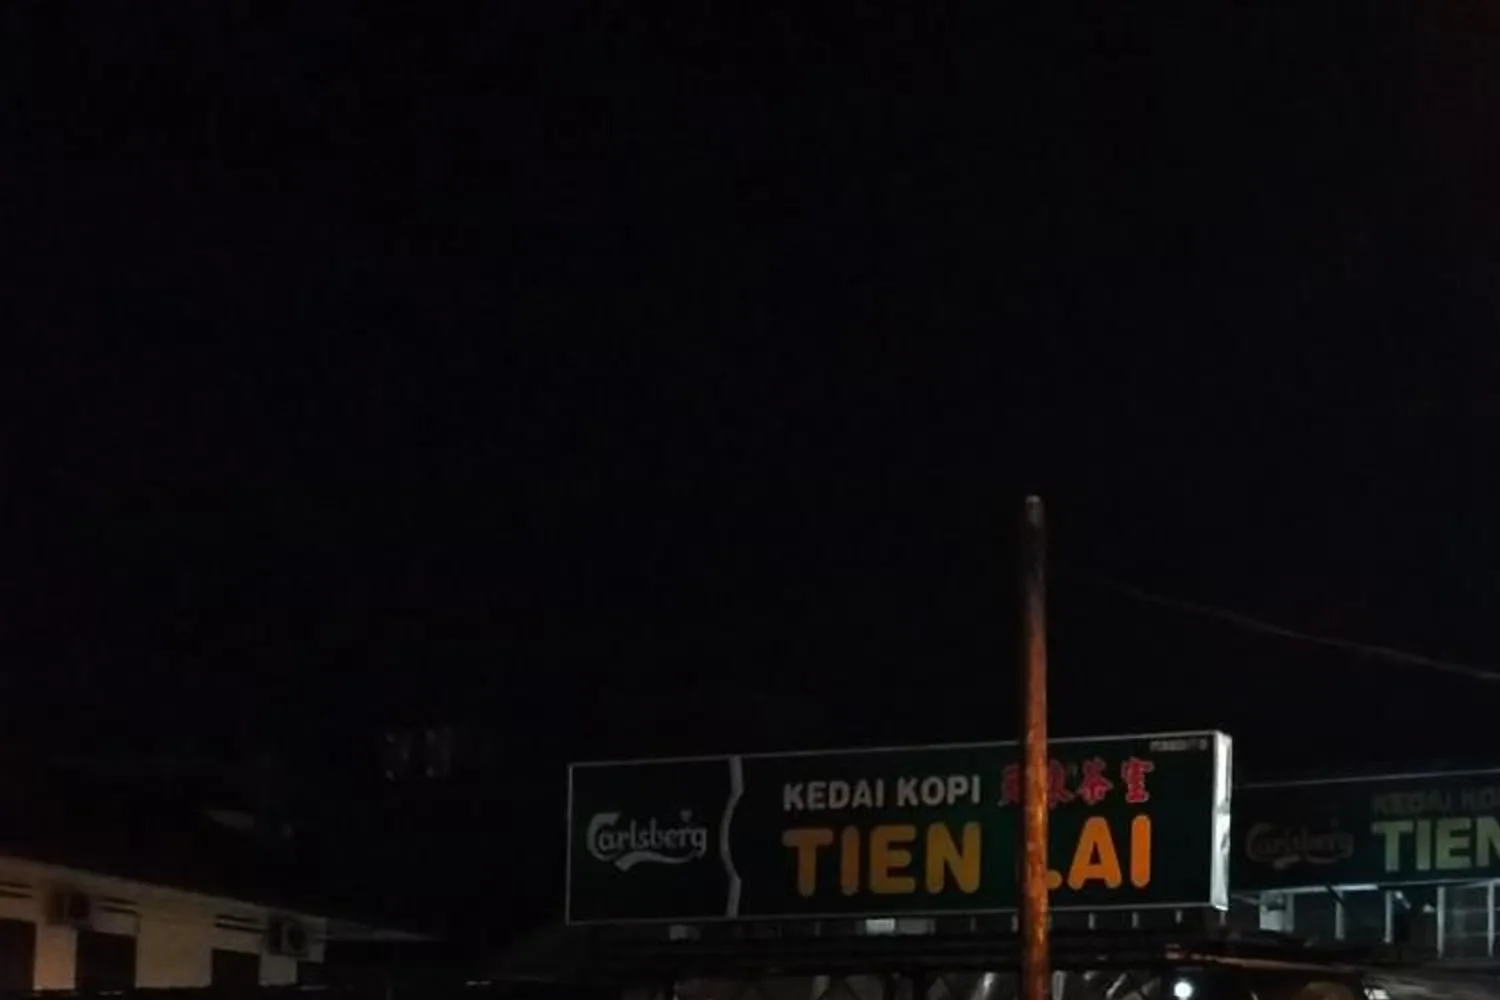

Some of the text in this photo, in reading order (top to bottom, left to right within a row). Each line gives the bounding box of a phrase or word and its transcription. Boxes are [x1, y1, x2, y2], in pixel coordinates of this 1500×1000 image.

[782, 774, 981, 811] KEDAI KOPI
[586, 810, 709, 866] Carlsberg
[781, 814, 1152, 897] TIEN AI
